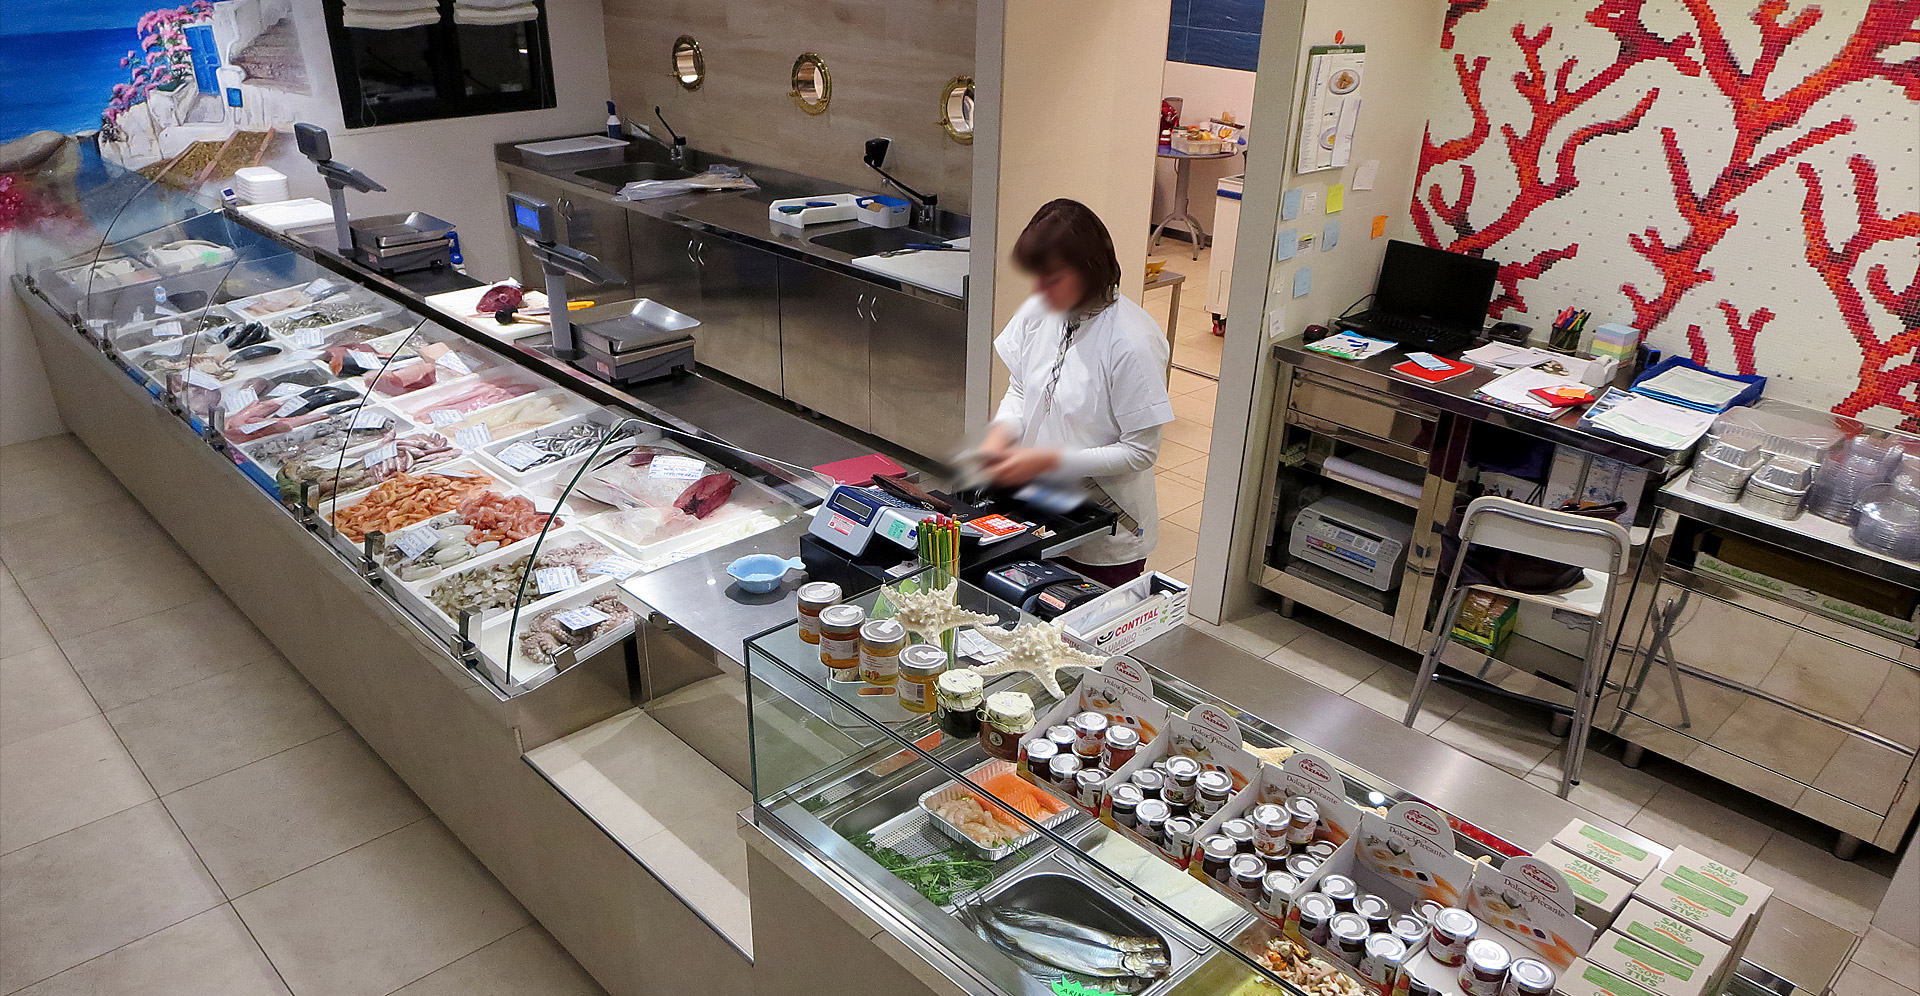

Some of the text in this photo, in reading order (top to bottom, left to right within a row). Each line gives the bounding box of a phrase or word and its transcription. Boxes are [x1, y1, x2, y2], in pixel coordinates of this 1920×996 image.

[1115, 607, 1159, 637] CONTITAL
[1104, 632, 1136, 651] LUMINIO
[1587, 843, 1622, 862] GROSSO
[1588, 850, 1614, 865] SALE
[1564, 864, 1600, 883] GROSSO
[1571, 859, 1601, 877] SALE
[1700, 865, 1737, 885] GROSSO
[1708, 862, 1738, 879] SALE
[1670, 897, 1709, 918] GROSSO
[1671, 904, 1702, 921] SALE
[1653, 921, 1693, 943] GROSSO
[1661, 917, 1693, 936] SALE
[1624, 961, 1665, 983] GROSSO
[1625, 969, 1658, 987] SALE
[1060, 988, 1089, 996] ARIN
